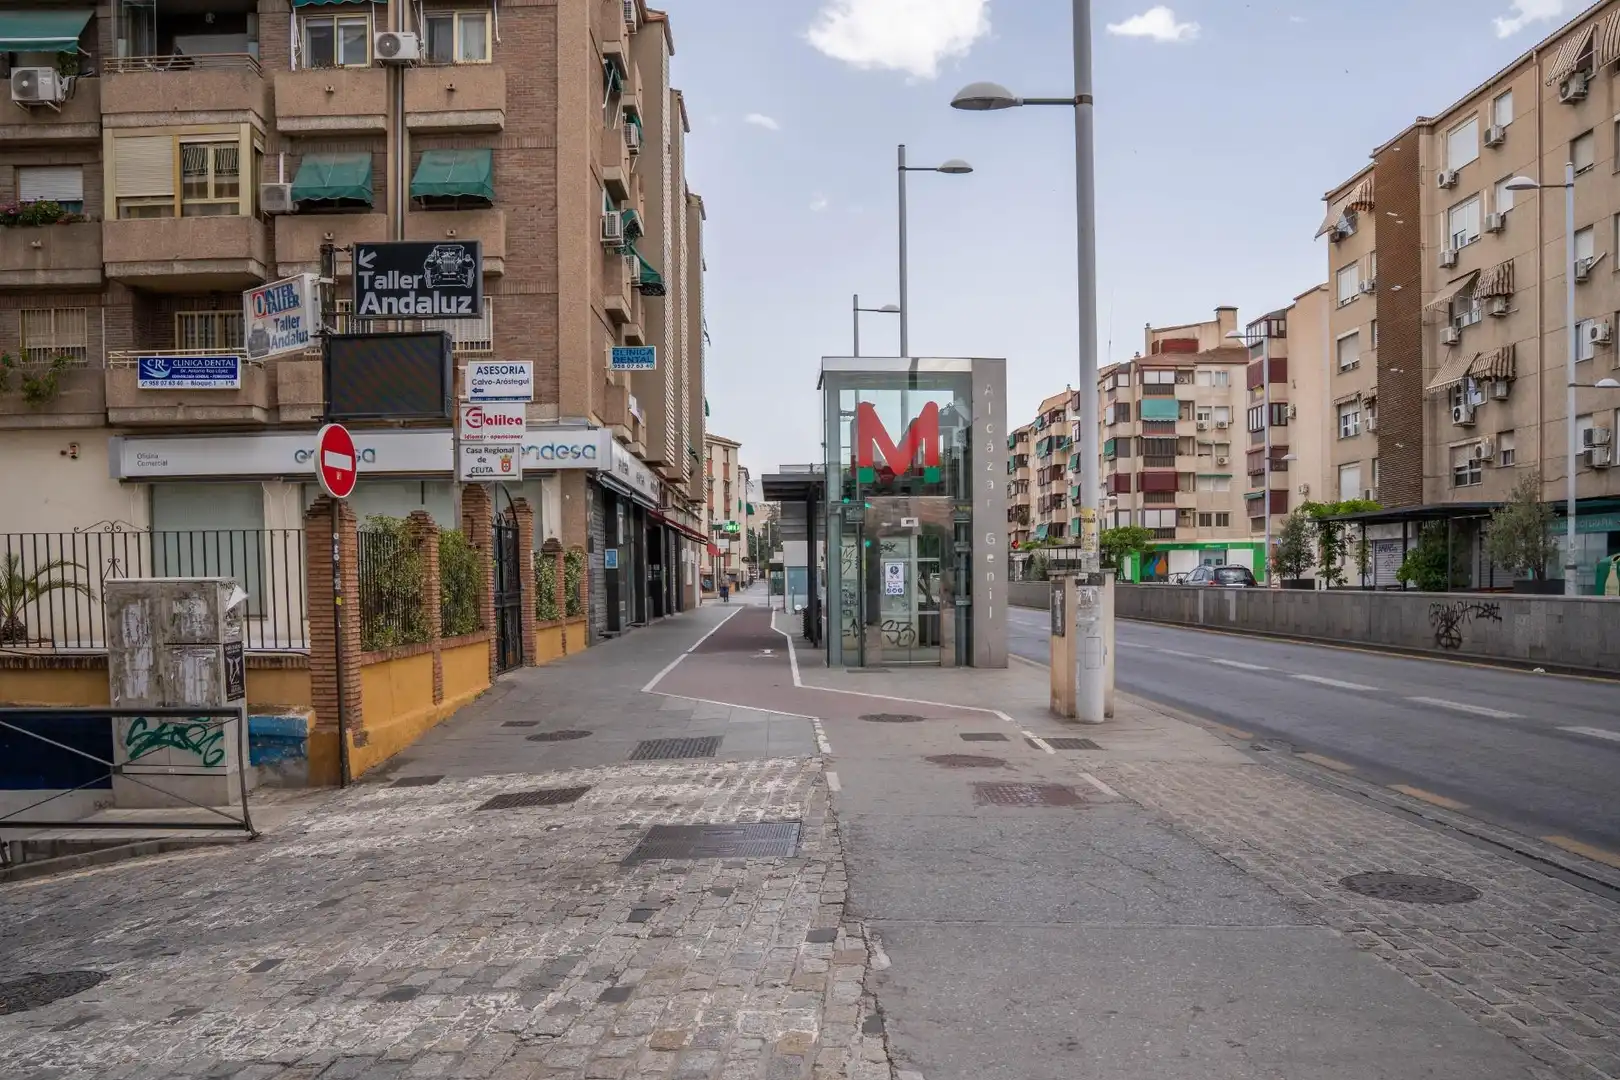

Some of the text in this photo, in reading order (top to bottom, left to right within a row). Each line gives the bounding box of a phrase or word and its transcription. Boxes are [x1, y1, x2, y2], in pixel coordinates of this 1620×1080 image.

[358, 270, 423, 289] Taller
[359, 290, 472, 314] Andaluz
[273, 315, 300, 333] Taller
[204, 359, 235, 367] DENTAL
[476, 365, 526, 375] ASESORIA
[471, 378, 530, 387] Calvo-Aróstegui
[465, 407, 523, 429] Galilea
[857, 400, 939, 482] M
[483, 446, 515, 455] Regional
[470, 466, 494, 474] CEUTA
[984, 384, 996, 619] Alcázar Genil
